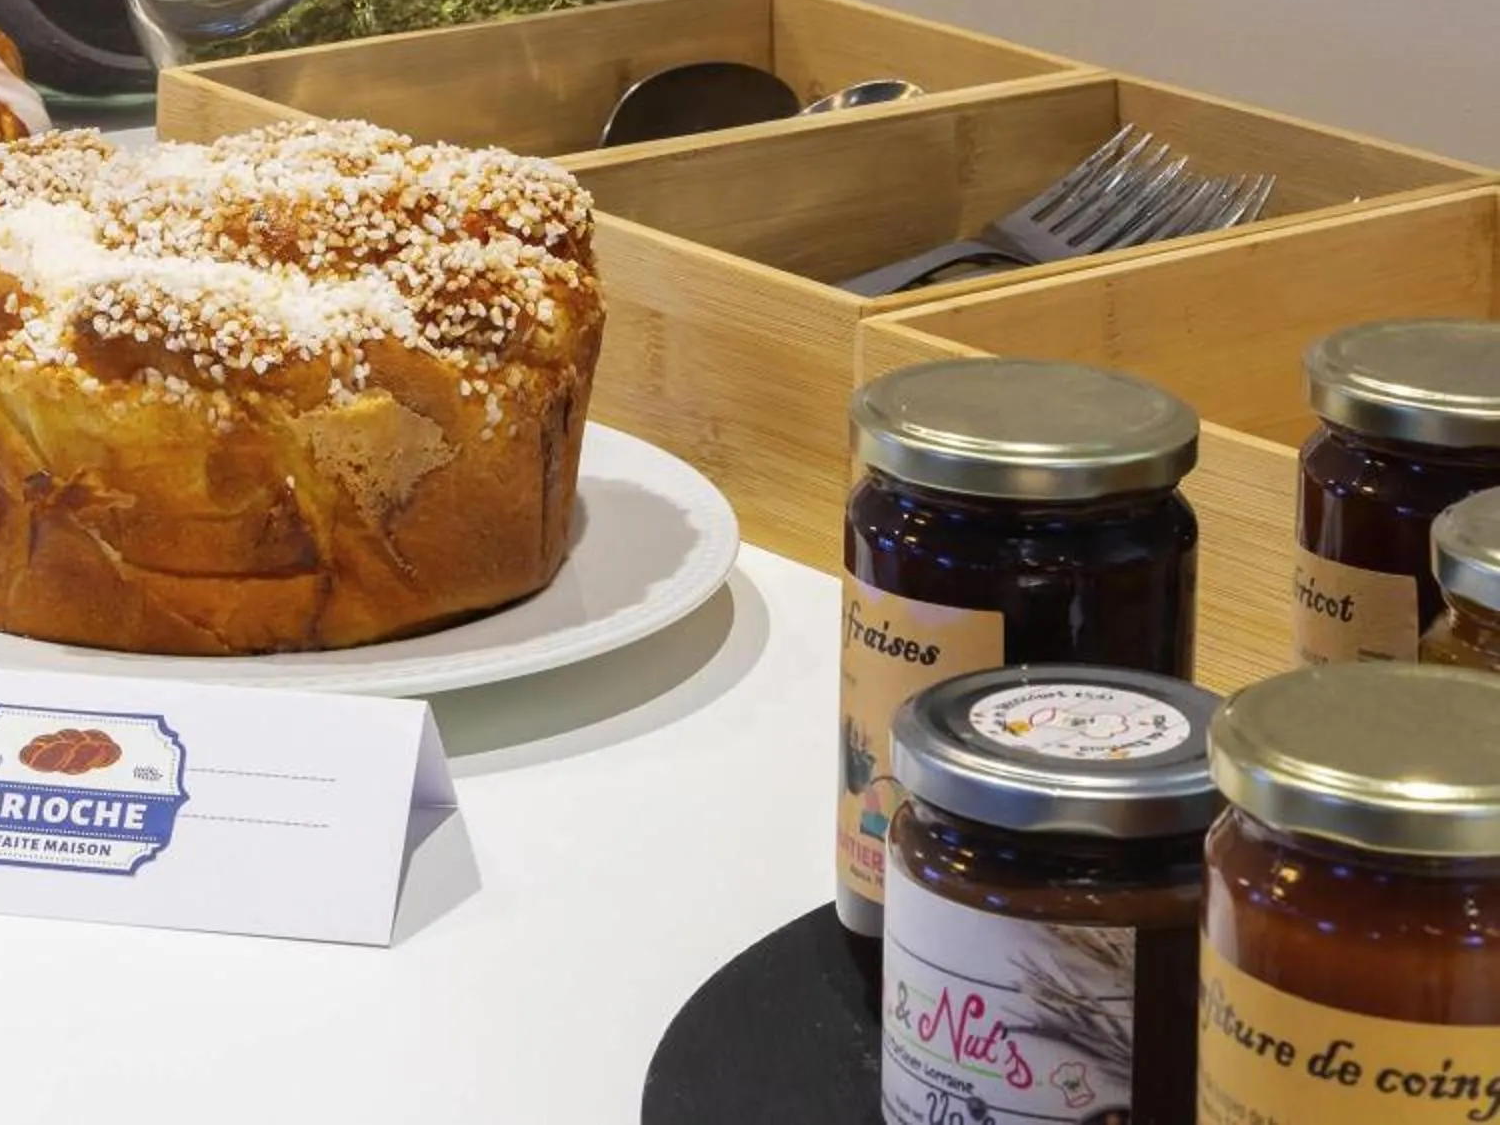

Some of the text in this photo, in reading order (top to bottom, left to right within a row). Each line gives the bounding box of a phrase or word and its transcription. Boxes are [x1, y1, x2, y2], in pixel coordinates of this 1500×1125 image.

[843, 600, 940, 666] fraises
[43, 837, 113, 857] MAISON
[918, 986, 1033, 1090] Nut's
[1307, 1040, 1362, 1086] de
